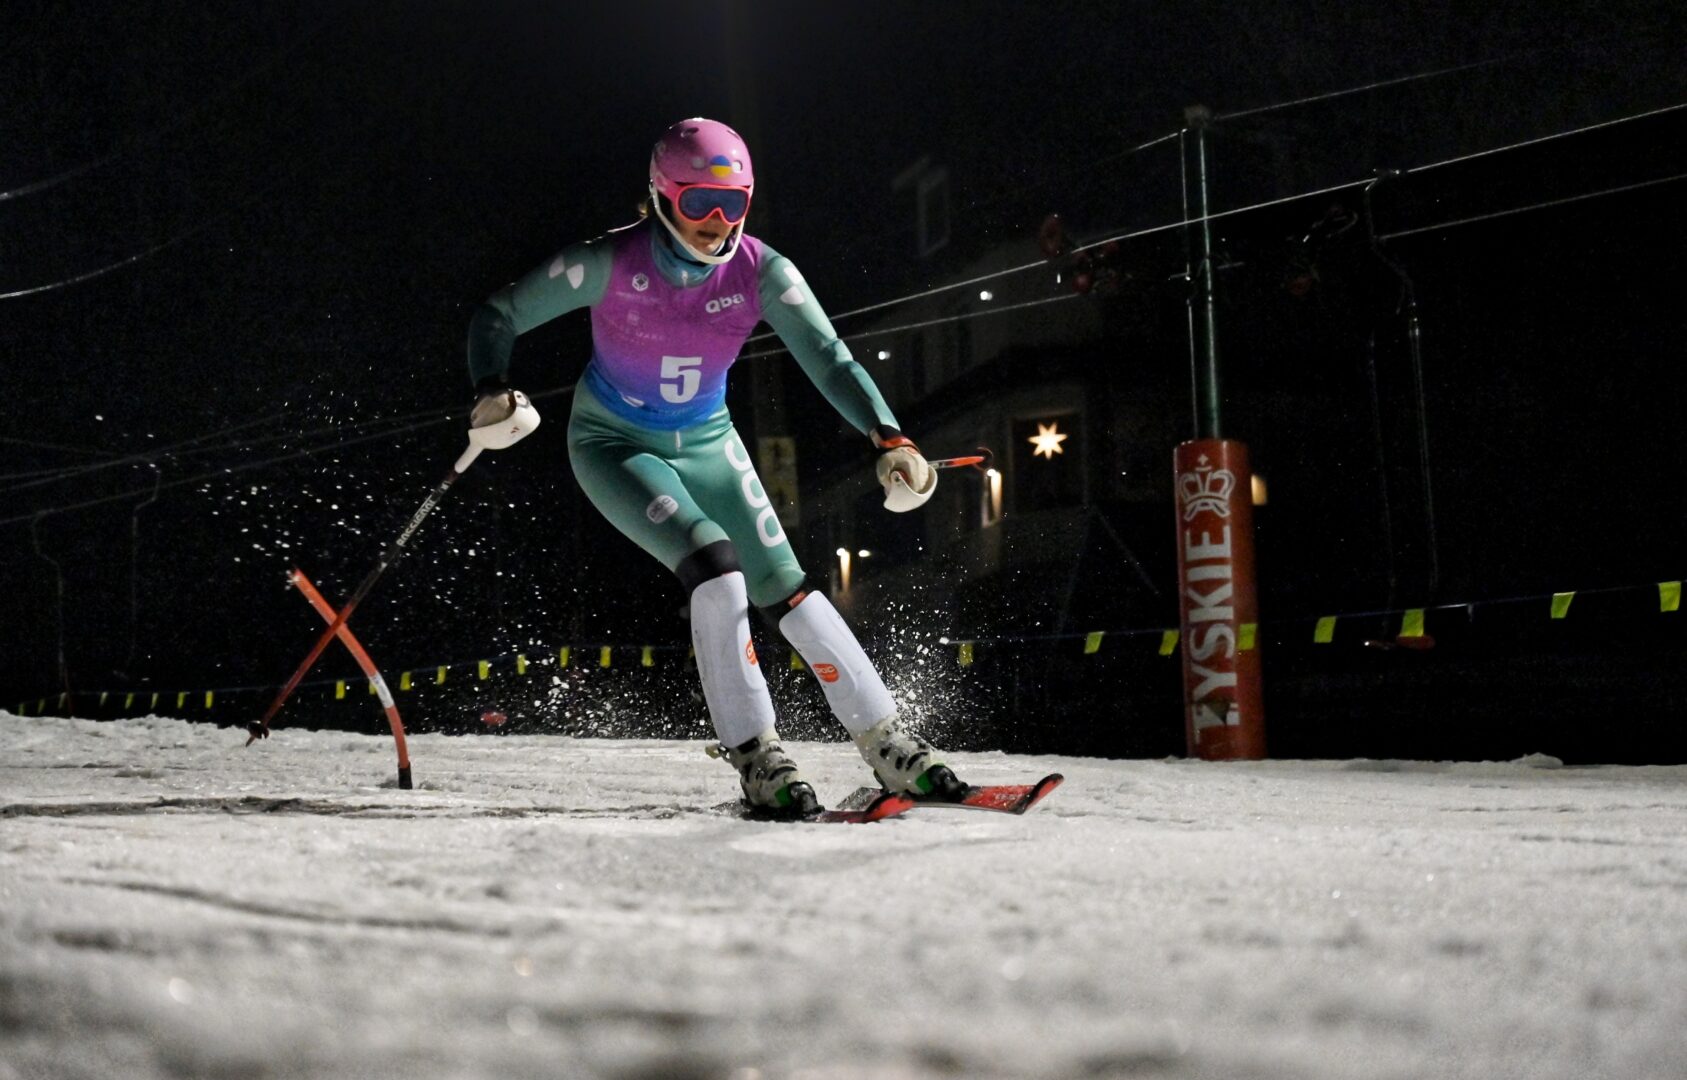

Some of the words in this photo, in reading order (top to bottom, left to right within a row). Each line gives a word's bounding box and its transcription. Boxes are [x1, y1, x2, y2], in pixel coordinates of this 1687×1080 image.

[705, 293, 745, 313] Qba
[659, 356, 702, 404] 5
[1185, 524, 1240, 744] TYSKIE
